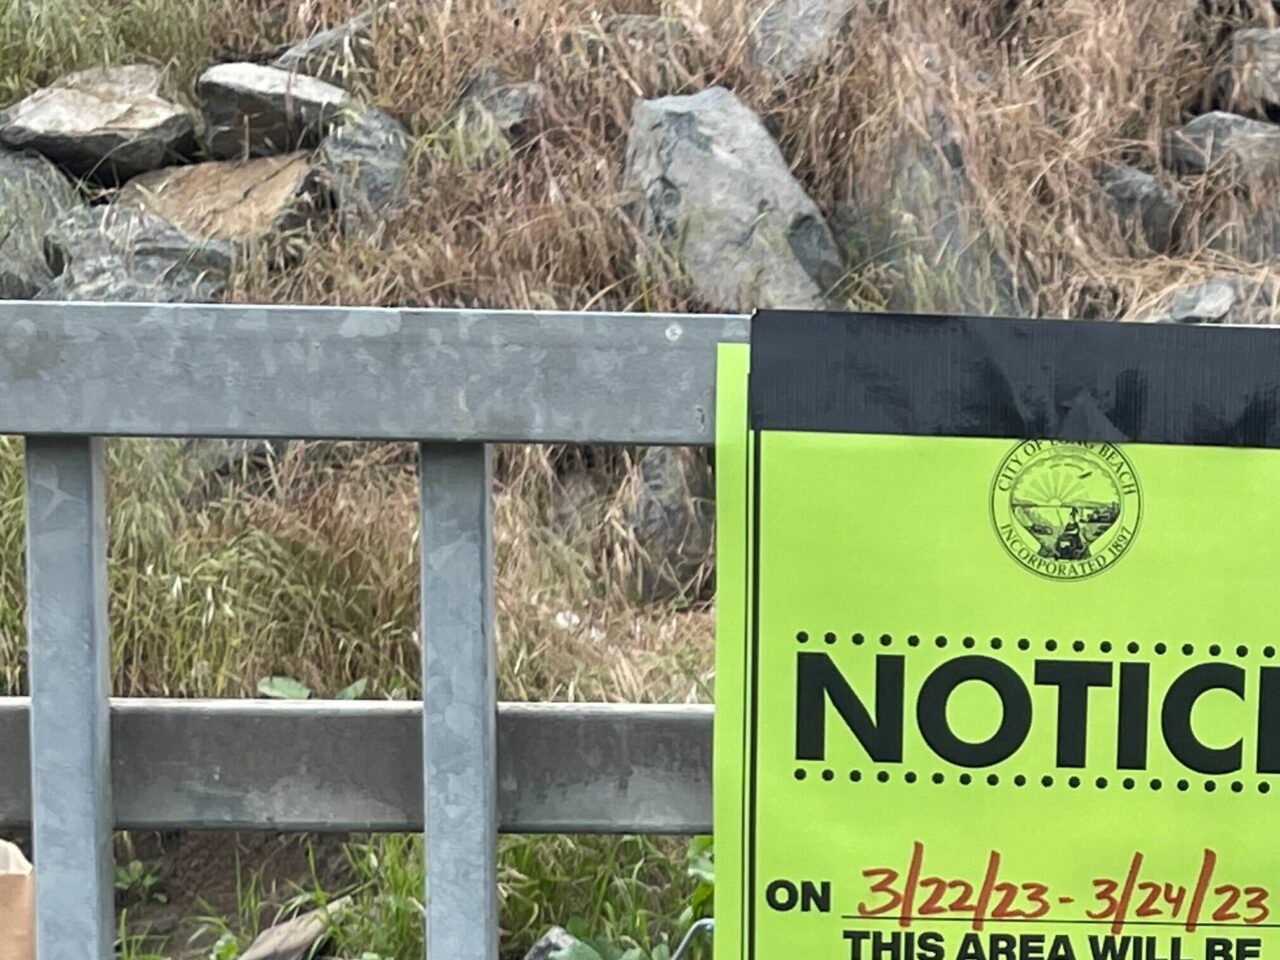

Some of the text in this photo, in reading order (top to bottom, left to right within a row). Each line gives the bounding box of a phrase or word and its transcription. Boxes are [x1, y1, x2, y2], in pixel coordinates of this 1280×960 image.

[998, 453, 1023, 493] CITY
[1097, 443, 1137, 496] BEACH
[1000, 523, 1132, 577] INCORPORATED 1897
[766, 880, 830, 912] ON
[1085, 848, 1270, 934] 3/24/23
